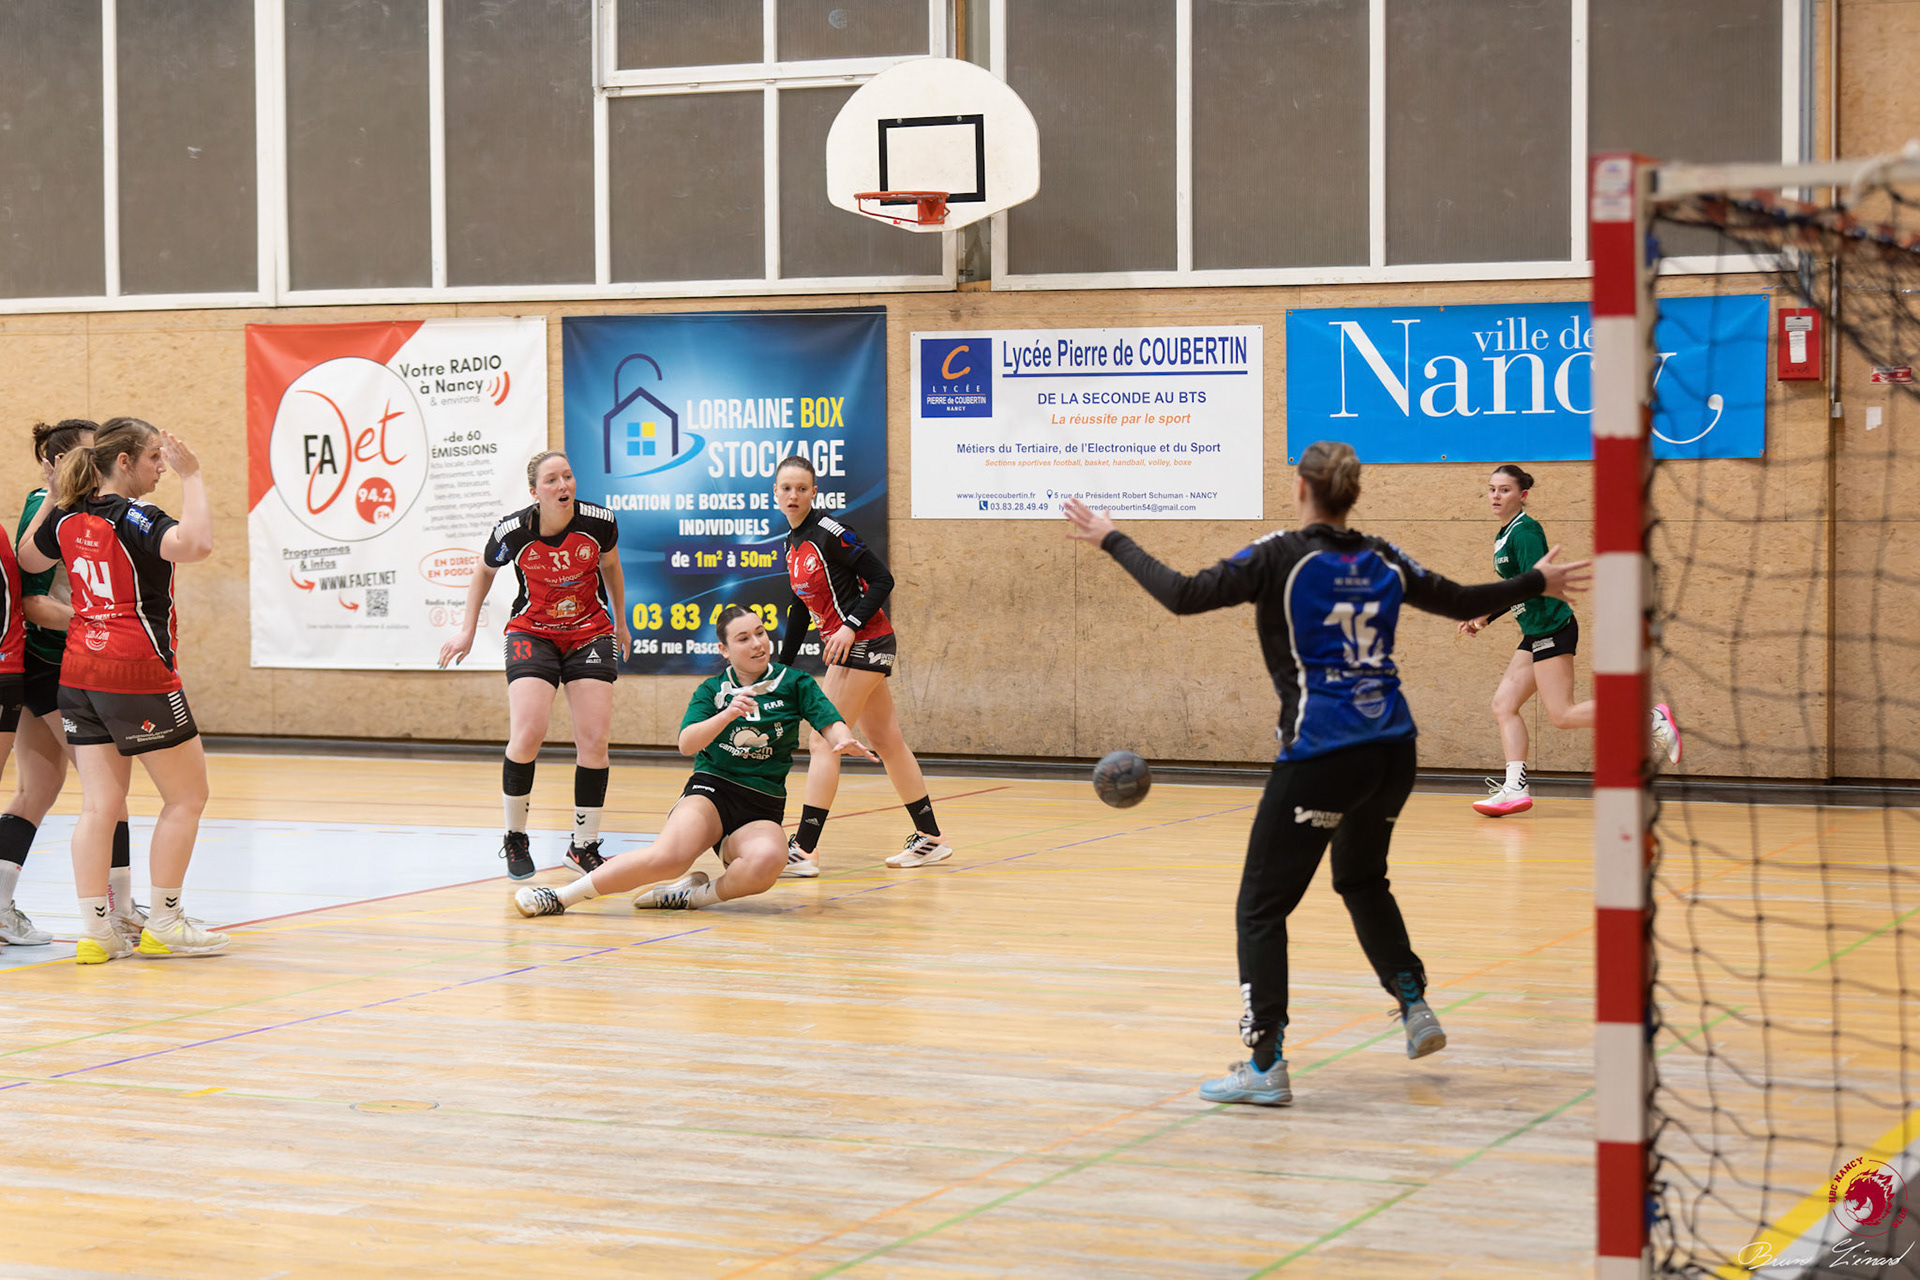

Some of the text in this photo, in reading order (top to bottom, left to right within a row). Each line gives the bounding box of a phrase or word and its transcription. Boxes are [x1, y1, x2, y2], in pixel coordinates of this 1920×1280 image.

[1472, 317, 1549, 352] ville
[941, 345, 971, 380] C
[1003, 336, 1247, 374] Lycée Pierre de COUBERTIN
[399, 355, 502, 378] Votre RADIO
[420, 379, 484, 395] à Nancy
[932, 384, 981, 393] LYCÉE
[926, 396, 987, 405] PIERRE de COUBERTIN
[1038, 391, 1207, 405] DE LA SECONDE AU BTS
[687, 397, 845, 430] LORRAINE BOX
[1051, 412, 1191, 427] La réussite par le sport
[467, 430, 481, 441] 60
[431, 443, 498, 458] ÉMISSIONS
[956, 442, 1221, 454] Métiers du Tertiaire, de l'Electronique et du Sport
[985, 459, 1016, 467] Sections
[1018, 459, 1051, 468] sportives
[1053, 459, 1082, 467] football,
[1084, 459, 1110, 467] basket,
[1113, 459, 1146, 467] handball,
[1148, 459, 1171, 468] volley,
[357, 488, 394, 503] 94.2
[605, 491, 846, 511] LOCATION DE BOXES DE SAGE
[957, 492, 1036, 501] www.lyceecoubertin.fr
[1074, 491, 1084, 499] du
[1085, 491, 1120, 499] Président
[1122, 491, 1147, 499] Robert
[1149, 491, 1183, 499] Schuman
[1190, 491, 1218, 499] NANCY
[990, 502, 1049, 511] 03.83.28.49.49
[377, 510, 390, 520] FM
[679, 518, 770, 537] INDIVIDUELS
[283, 545, 351, 559] Programmes
[671, 550, 778, 568] de 1m² à 50m²
[311, 558, 336, 569] Infos
[548, 550, 570, 572] 33
[444, 568, 474, 577] PODCA
[71, 556, 115, 612] 14
[319, 570, 397, 591] WWW.FAJET.NET
[632, 603, 663, 630] 03
[670, 603, 701, 630] 83
[709, 603, 737, 625] 4
[512, 640, 532, 661] 33
[633, 639, 658, 655] 256
[662, 642, 683, 655] rue
[686, 639, 720, 655] Pasca
